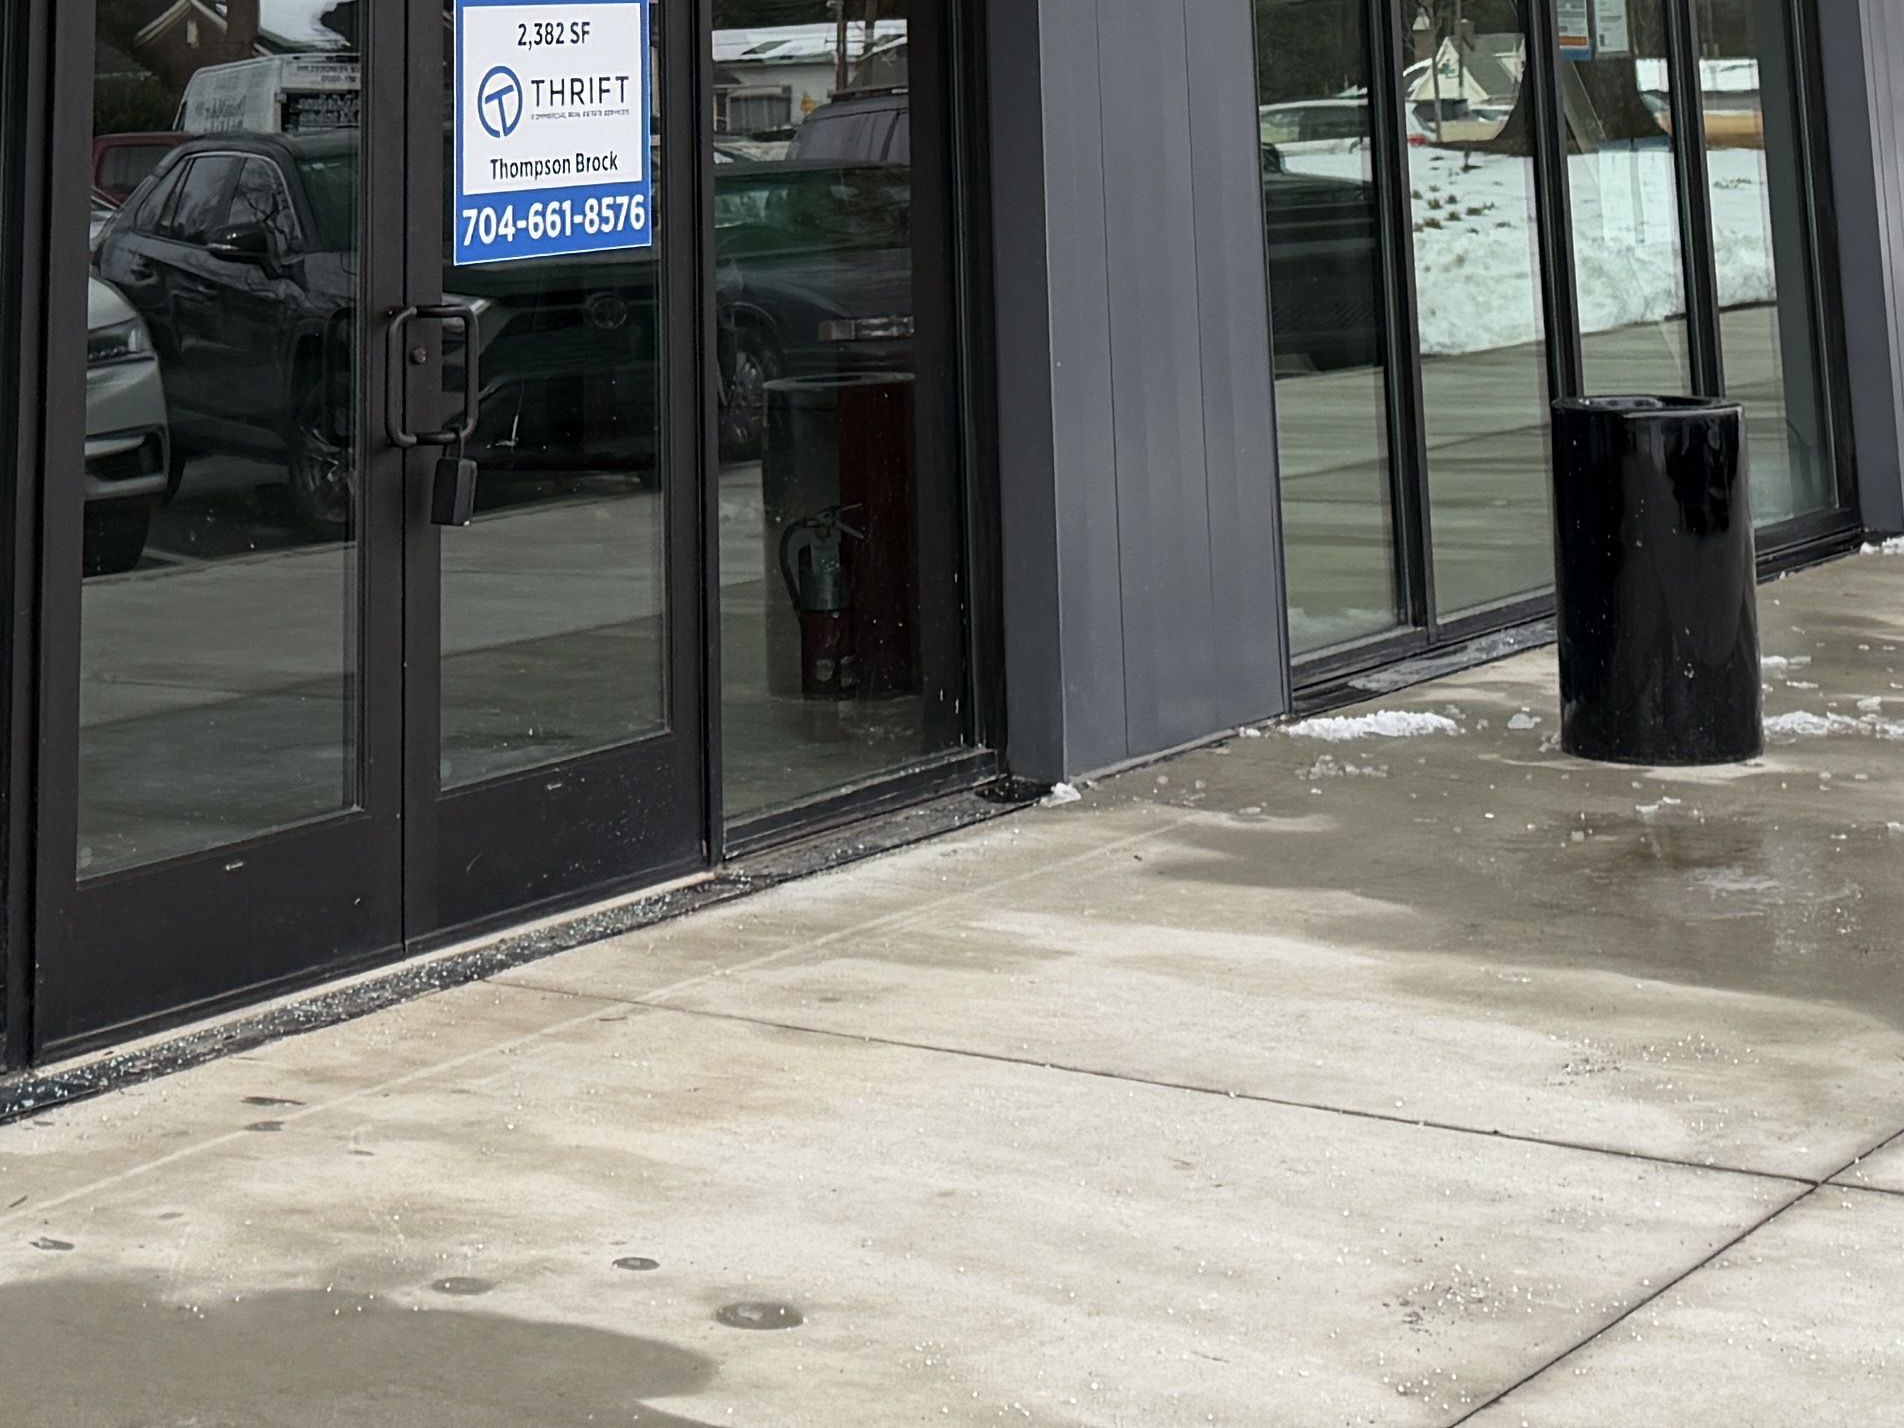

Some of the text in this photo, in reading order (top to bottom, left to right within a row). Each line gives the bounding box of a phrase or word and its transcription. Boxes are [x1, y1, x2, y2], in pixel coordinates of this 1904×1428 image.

[517, 21, 591, 51] 2,382 SF
[530, 76, 630, 108] THRIFT
[490, 150, 618, 181] Thompson Brock
[462, 194, 645, 246] 704-661-8576
